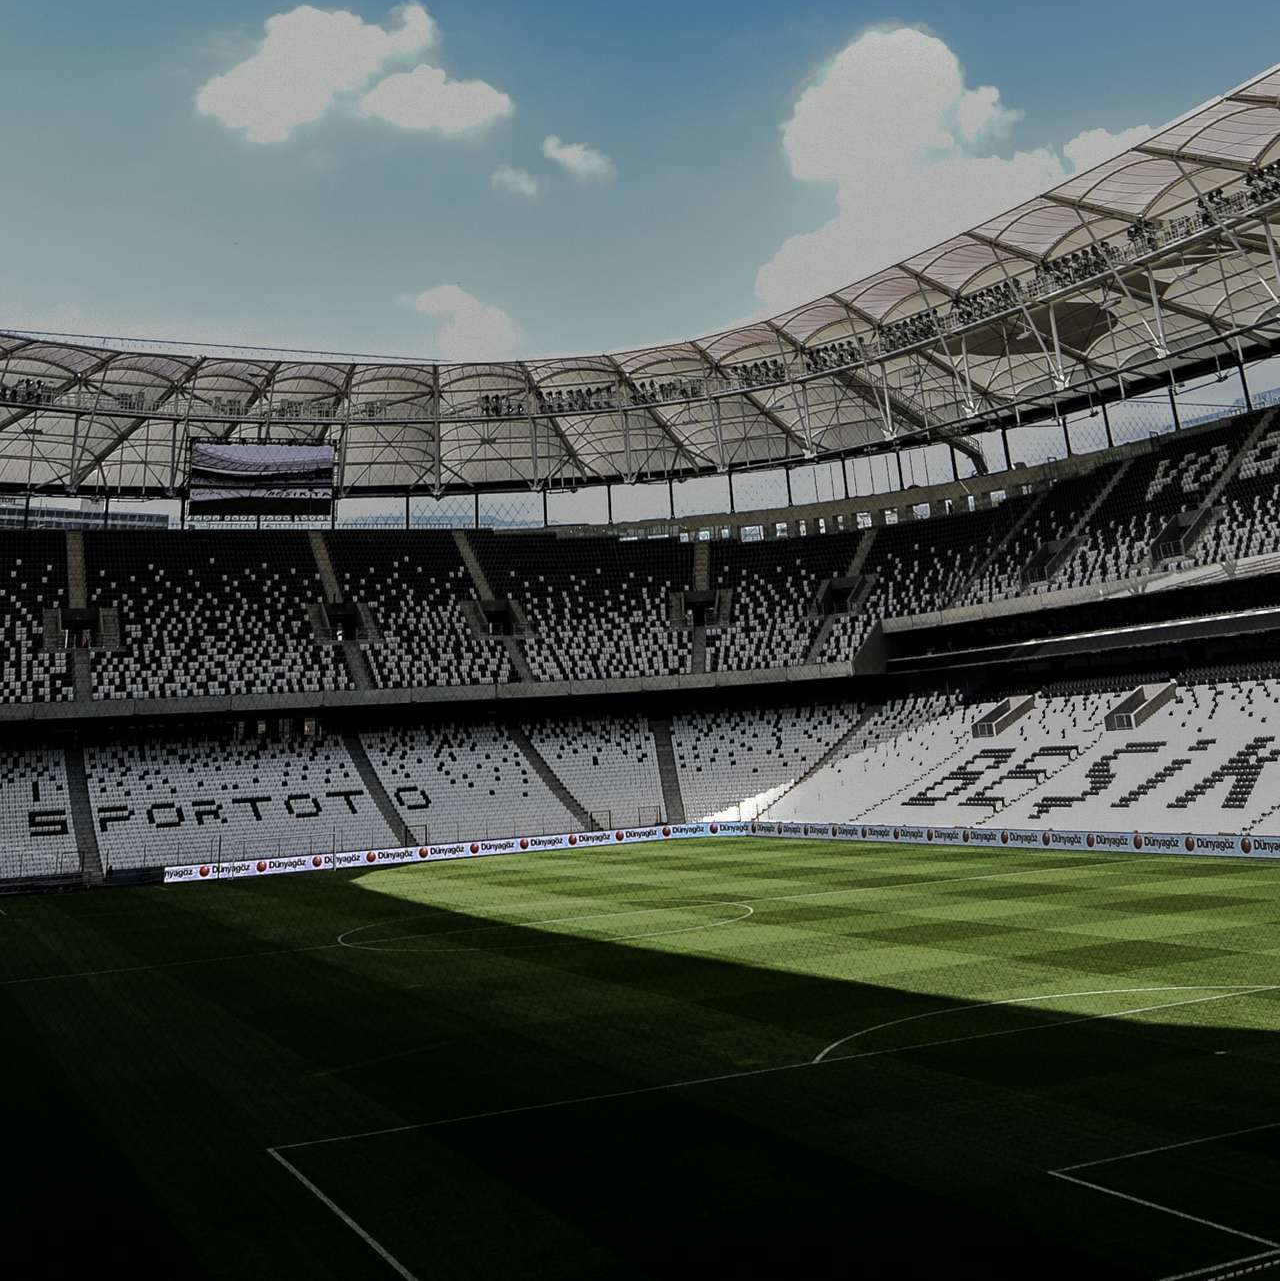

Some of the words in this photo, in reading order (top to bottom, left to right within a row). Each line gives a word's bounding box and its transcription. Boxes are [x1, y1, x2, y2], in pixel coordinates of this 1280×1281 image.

[269, 858, 306, 869] Dünyagöz
[378, 850, 413, 860] Dünyagöz
[430, 845, 464, 855] Dünyagöz
[481, 841, 514, 851] Dünyagöz
[530, 837, 563, 847] Dünyagöz
[578, 833, 610, 843] Dünyagöz
[625, 829, 657, 838] Dünyagöz
[672, 825, 704, 835] Dünyagöz
[970, 831, 997, 842] Dünyagöz
[1009, 832, 1037, 843] Dünyagöz
[1051, 833, 1082, 845] Dünyagöz
[1095, 835, 1128, 847] Dünyagöz
[1144, 836, 1179, 848] Dünyagöz
[1196, 837, 1235, 850] Dünyagöz
